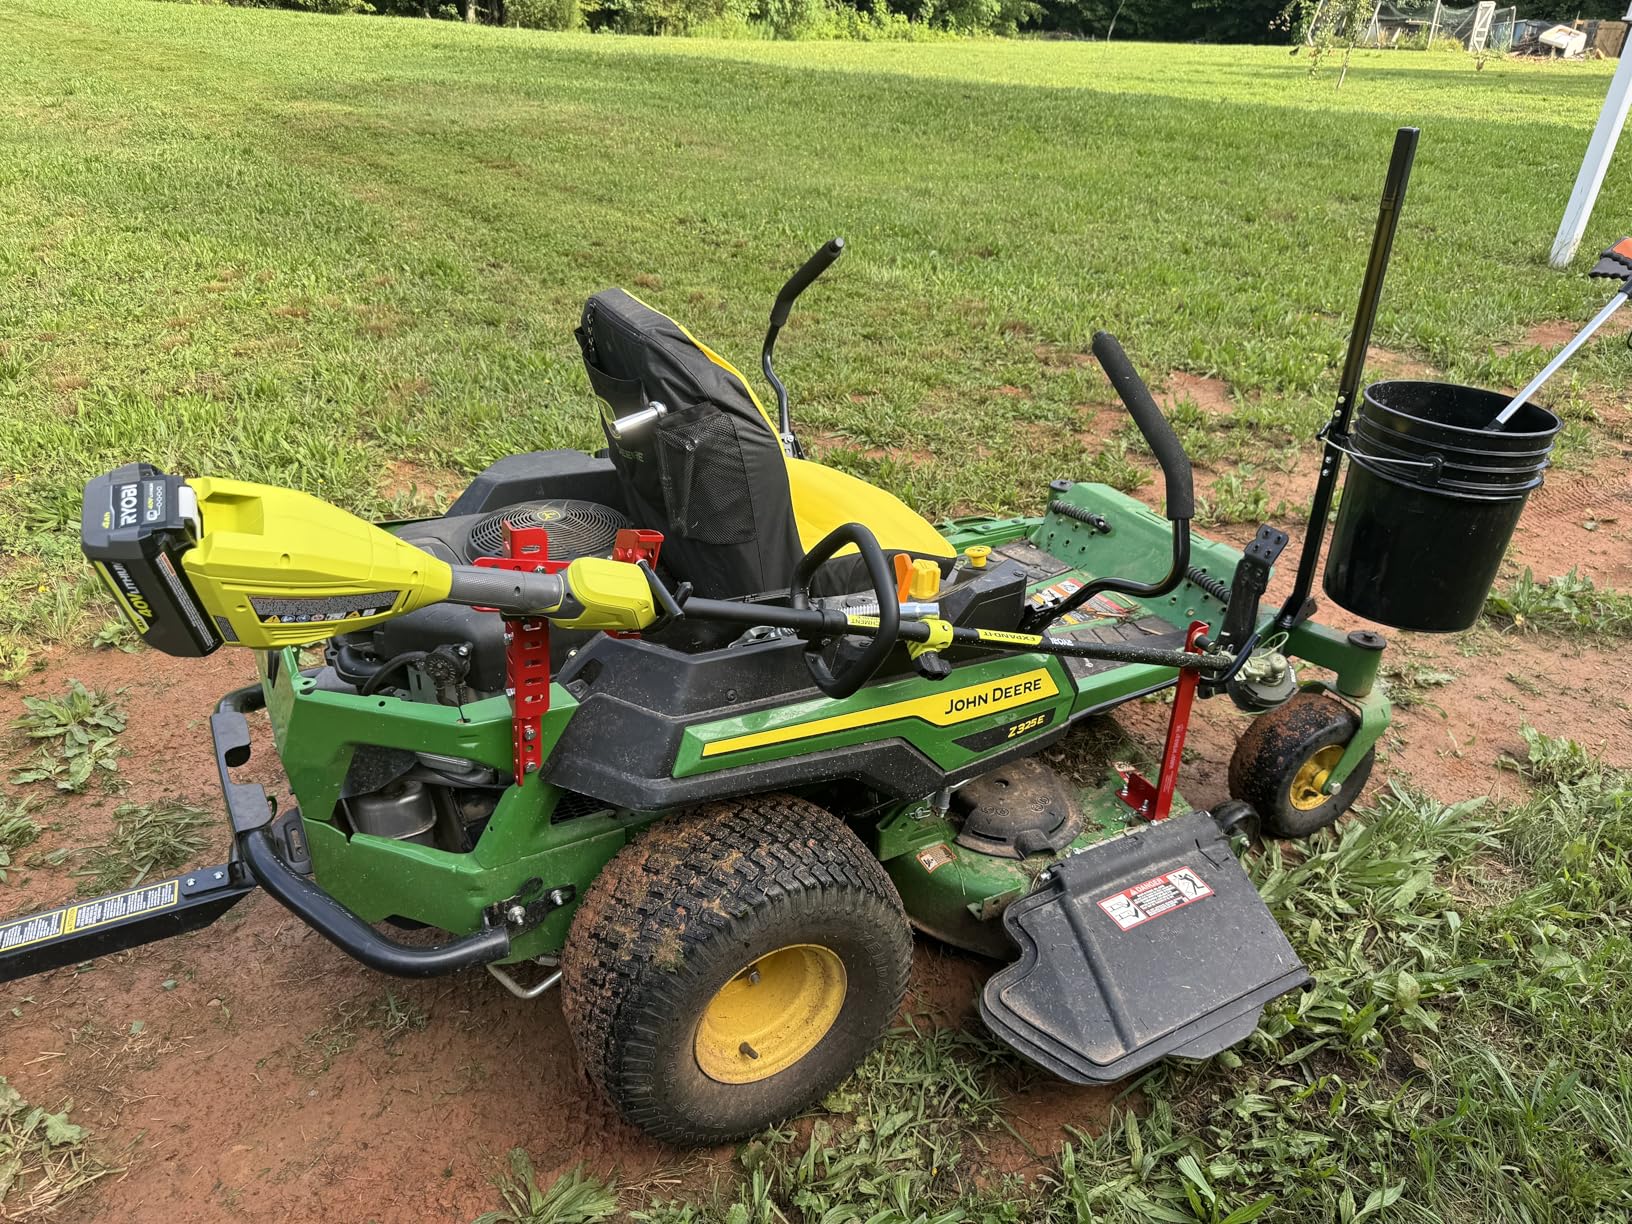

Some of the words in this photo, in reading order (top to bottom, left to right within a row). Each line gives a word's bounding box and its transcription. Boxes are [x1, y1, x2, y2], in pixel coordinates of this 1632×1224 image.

[120, 484, 138, 527] RYOBI
[102, 511, 111, 529] 4Ah
[983, 630, 1037, 642] EXPAND-IT
[944, 692, 990, 715] JOHN
[992, 678, 1042, 703] DEERE
[1007, 714, 1046, 738] Z325E
[1135, 877, 1166, 892] DANGER
